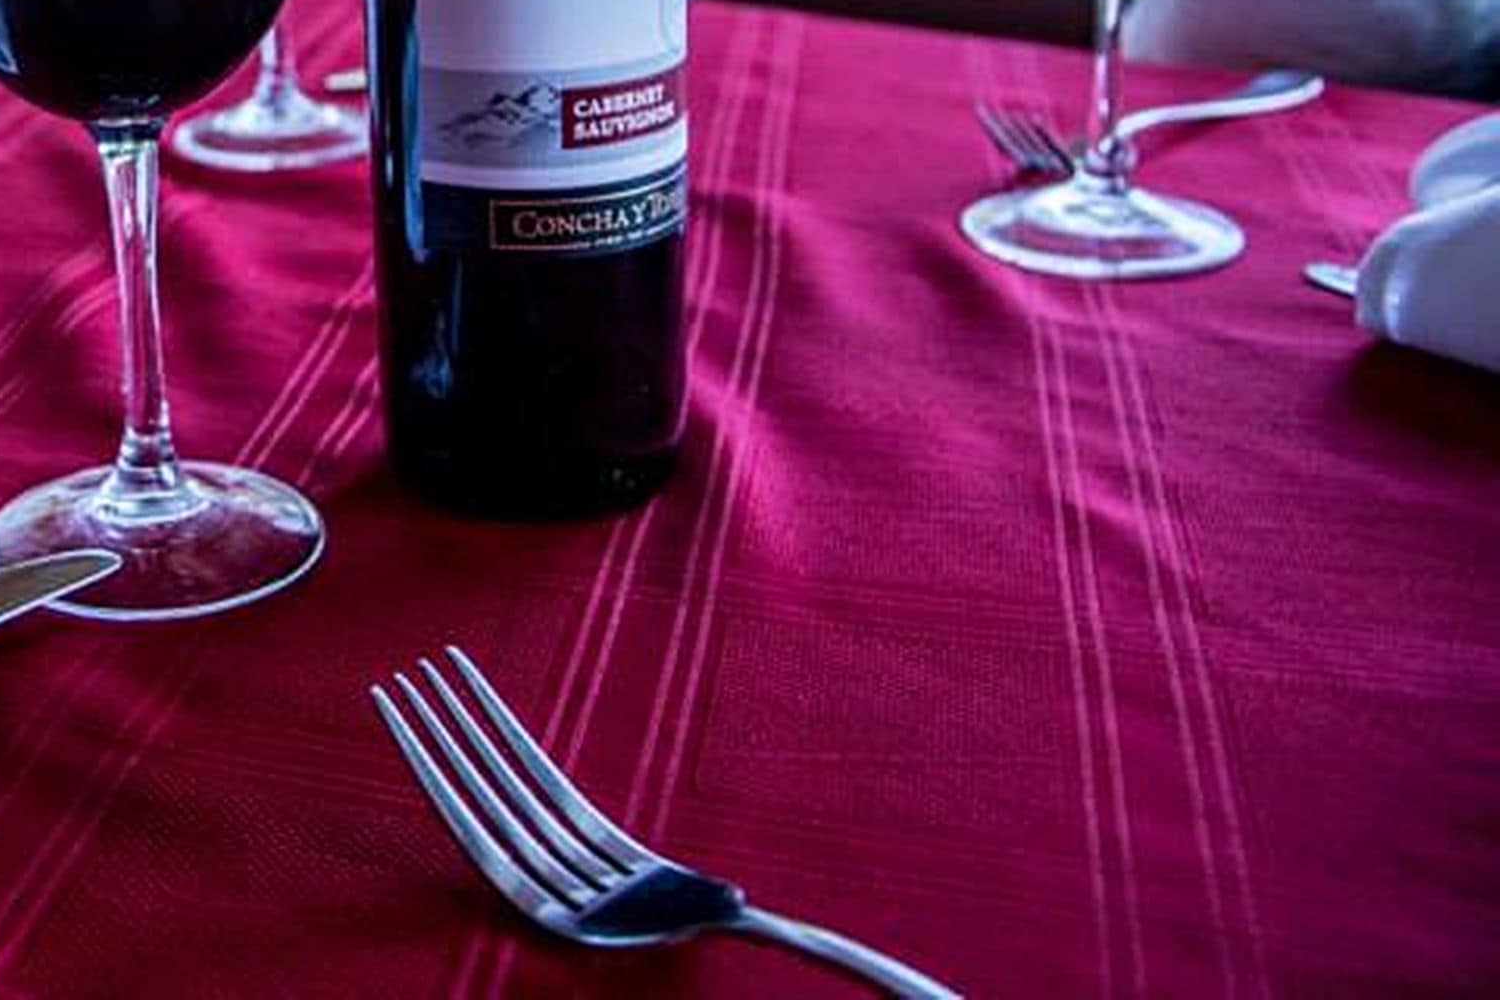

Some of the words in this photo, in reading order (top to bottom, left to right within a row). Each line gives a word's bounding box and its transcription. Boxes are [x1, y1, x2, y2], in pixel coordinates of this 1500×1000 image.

[573, 84, 665, 118] CABERNET
[573, 100, 675, 141] SAUVIGNON
[512, 209, 630, 238] CONCHA
[631, 201, 647, 225] Y
